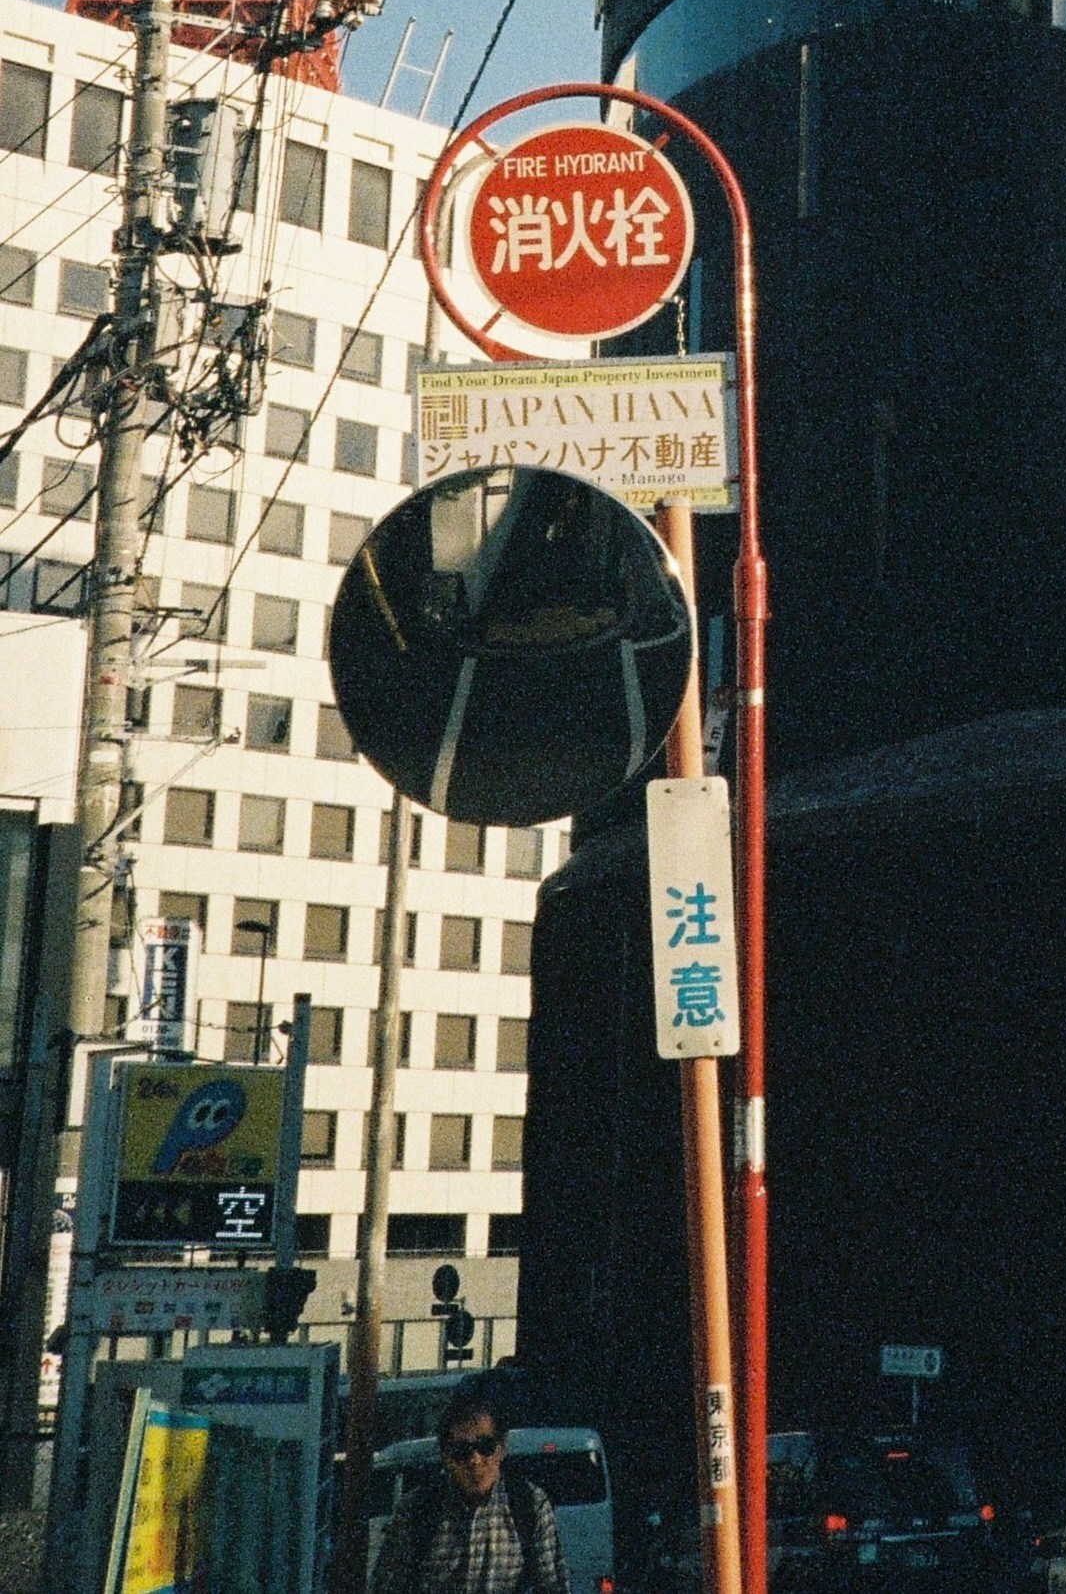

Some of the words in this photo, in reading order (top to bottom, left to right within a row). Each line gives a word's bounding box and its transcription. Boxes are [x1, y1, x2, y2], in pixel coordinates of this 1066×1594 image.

[504, 156, 547, 179] FIRE
[555, 151, 646, 176] HYDRANT
[489, 186, 671, 274] 消火栓
[421, 376, 452, 389] Find
[456, 375, 487, 387] Your
[493, 373, 538, 386] Dream
[541, 371, 579, 387] Japan
[583, 369, 641, 386] Property
[646, 367, 718, 381] Investment
[474, 393, 595, 433] JAPAN
[612, 388, 717, 423] HANA
[424, 430, 722, 478] ジャパンハナ不動産
[666, 882, 725, 1027] 注意
[215, 1185, 266, 1238] 空
[707, 1391, 730, 1483] 東京都
